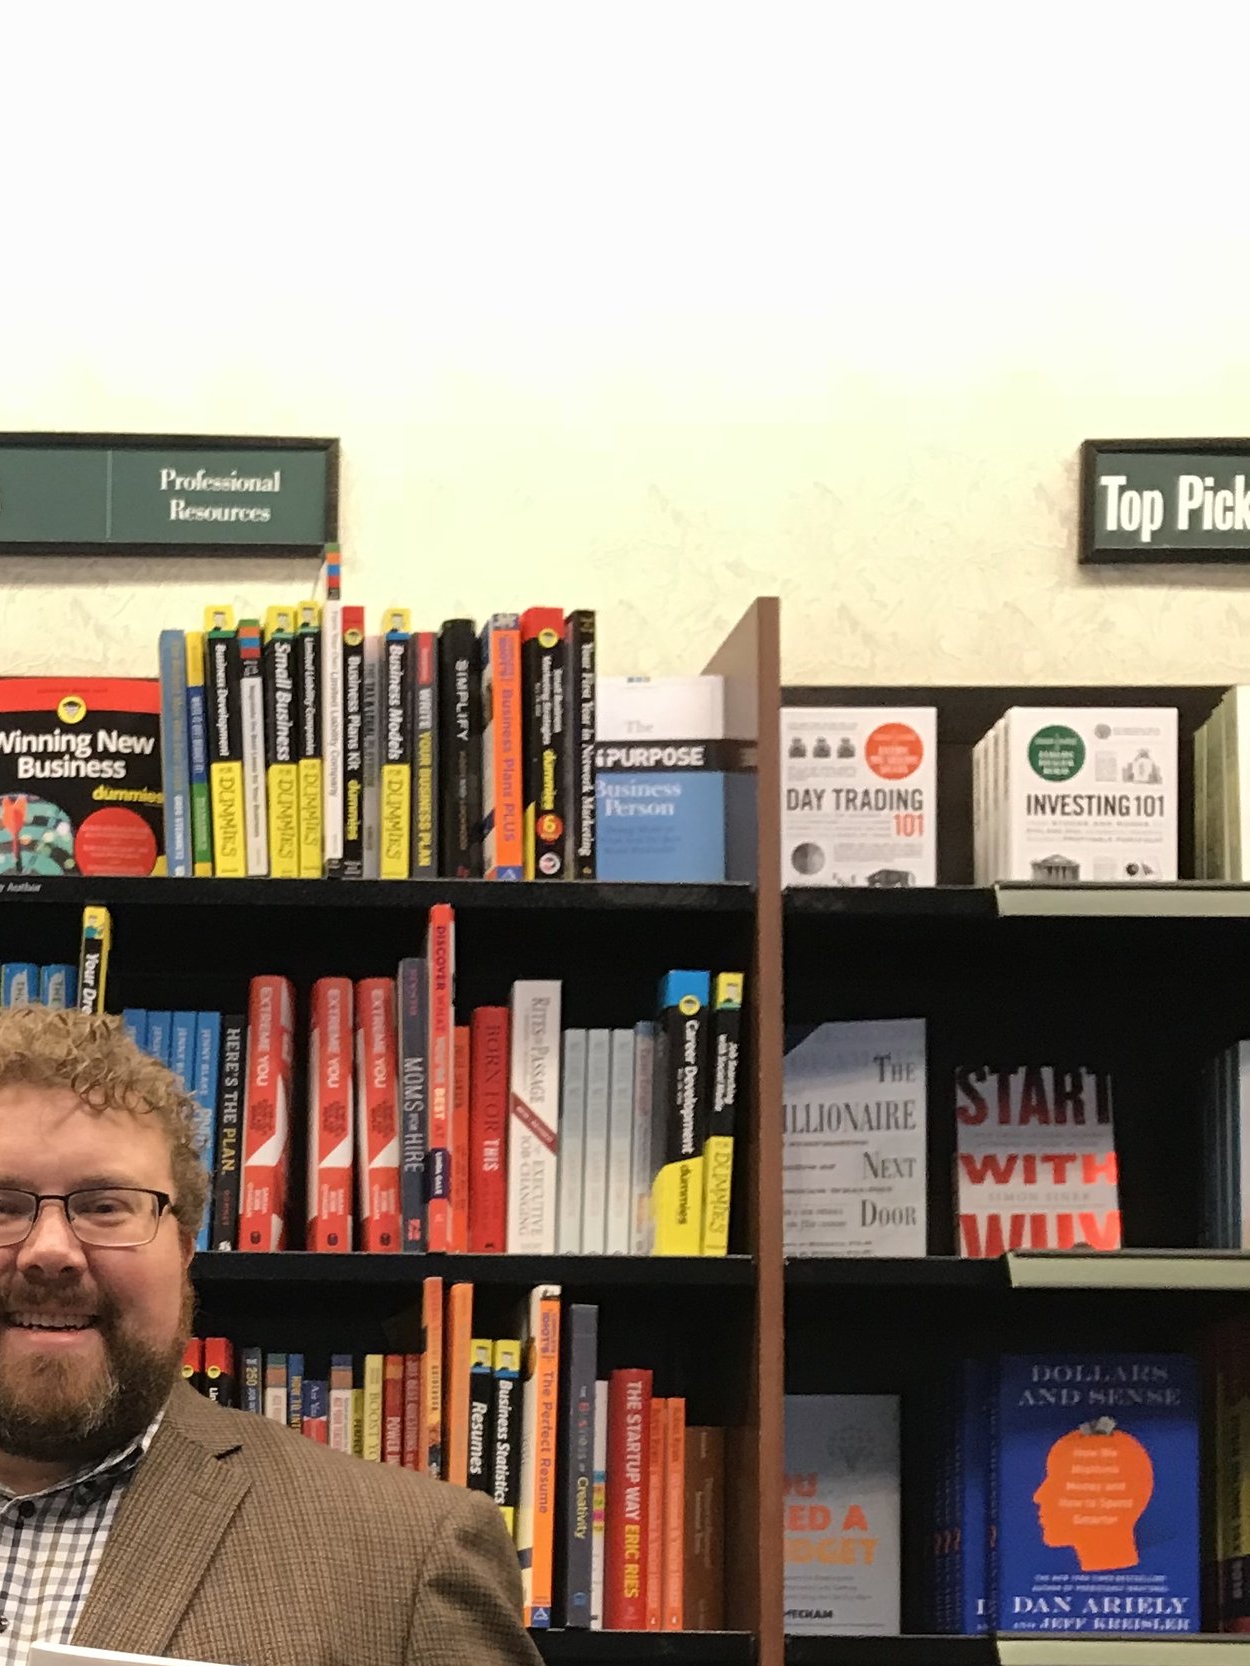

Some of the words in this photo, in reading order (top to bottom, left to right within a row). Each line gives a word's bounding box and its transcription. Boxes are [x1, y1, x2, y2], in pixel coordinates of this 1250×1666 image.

[160, 468, 280, 493] Professional
[169, 500, 271, 522] Resources
[1101, 476, 1163, 542] Top
[97, 730, 155, 757] New
[607, 746, 704, 766] PURPOSE
[18, 757, 126, 779] Business
[604, 799, 677, 817] Person
[786, 788, 824, 811] DAY
[832, 788, 923, 811] TRADING
[1027, 793, 1130, 817] INVESTING
[1134, 794, 1165, 817] 101
[894, 814, 923, 836] 101
[958, 1067, 1110, 1125] START
[783, 1103, 917, 1134] ILLIONAIRE
[959, 1153, 1118, 1185] WITH
[626, 1381, 642, 1411] THE
[1019, 1389, 1080, 1406] AND
[470, 1402, 486, 1474] Resumes
[625, 1415, 641, 1486] STARTUP
[625, 1489, 640, 1520] WAY
[625, 1525, 639, 1558] ERIC
[624, 1563, 637, 1599] RIES
[1013, 1596, 1072, 1614] DAN
[1082, 1596, 1189, 1615] ARIELY
